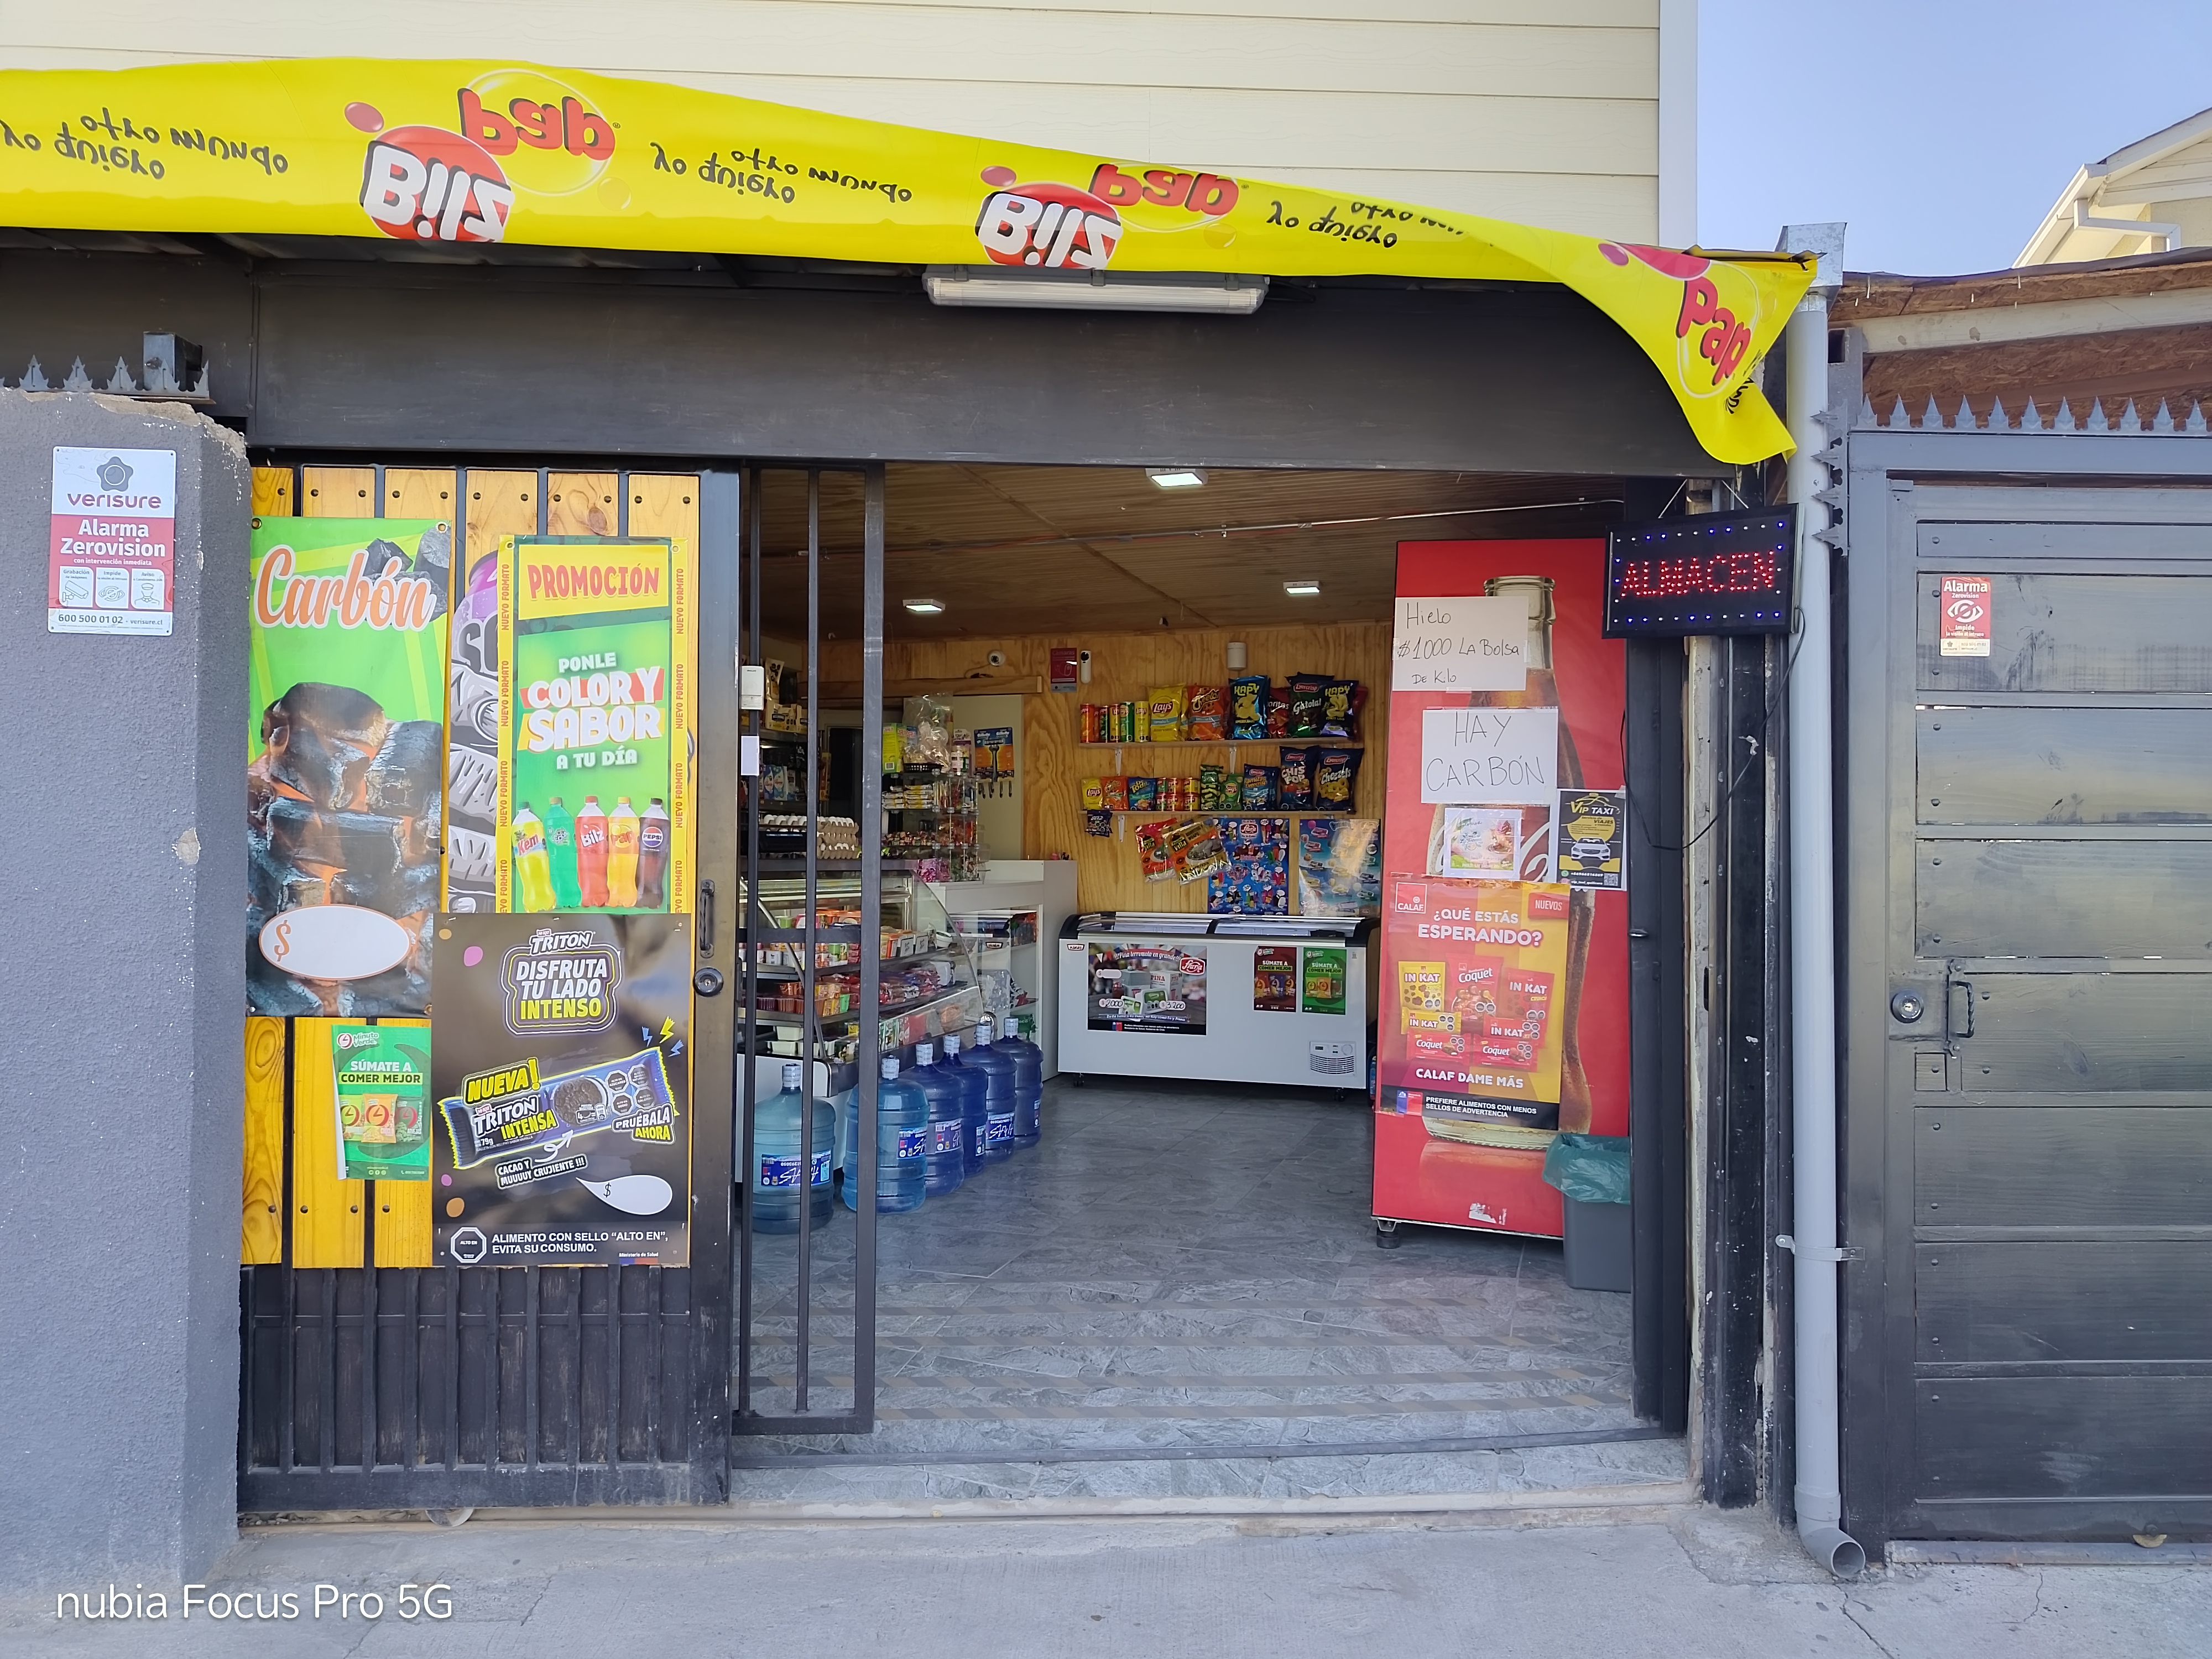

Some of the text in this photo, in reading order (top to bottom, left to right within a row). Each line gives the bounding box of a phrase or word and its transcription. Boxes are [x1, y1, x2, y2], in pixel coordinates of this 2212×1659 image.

[67, 493, 161, 509] verisure
[79, 519, 149, 538] Alarma
[60, 537, 165, 557] Zerovision
[528, 564, 659, 600] PROMOCIÓN
[1621, 551, 1773, 597] ALMACEN
[256, 546, 435, 630] Carbón
[1943, 580, 1987, 592] Alarma
[501, 564, 510, 630] NUEVO FORMATO
[1406, 602, 1452, 629] Hielo
[1397, 636, 1452, 660] $1000
[1480, 639, 1520, 656] Bolsa
[559, 652, 617, 672] PONLE
[1434, 668, 1457, 684] Kilo
[528, 666, 661, 708] COLOR Y
[528, 705, 662, 753] SABOR
[1454, 711, 1511, 747] HAY
[557, 745, 637, 769] A TU DÍA
[500, 760, 508, 797] FORMATO
[1426, 756, 1545, 792] CARBÓN
[518, 833, 539, 856] Kem
[581, 830, 604, 847] Bilz
[1433, 907, 1519, 924] ¿QUÉ ESTÁS
[1535, 900, 1563, 911] NUEVOS
[274, 920, 291, 962] $
[533, 933, 590, 953] TRITON
[1418, 924, 1542, 946] ESPERANDO?
[517, 958, 607, 980] DISFRUTA
[1404, 973, 1440, 983] IN KAT
[1459, 968, 1493, 983] Coquet
[521, 979, 601, 1000] TU LADO
[520, 998, 601, 1020] INTENSO
[353, 1032, 378, 1042] Minuto
[1491, 1027, 1524, 1037] IN KAT
[1416, 1039, 1443, 1050] Coquet
[351, 1059, 412, 1072] SÚMATE A
[341, 1074, 420, 1083] COMER MEJOR
[1416, 1068, 1524, 1088] CALAF DAME MÁS
[1426, 1097, 1457, 1105] PREFIERE
[1458, 1100, 1496, 1110] ALIMENTOS
[1513, 1106, 1537, 1114] MENOS
[1462, 1108, 1508, 1118] ADVERTENCIA
[474, 1098, 536, 1135] TRITON
[500, 1109, 557, 1140] INTENSA
[615, 1107, 670, 1129] PRUÉBALA
[481, 1138, 494, 1146] 79g
[635, 1125, 671, 1140] AHORA
[498, 1160, 529, 1175] CACAO Y
[534, 1160, 575, 1177] CRUJIENTE
[603, 1182, 612, 1198] $
[492, 1233, 546, 1244] ALIMENTO
[549, 1233, 572, 1242] CON
[574, 1232, 609, 1242] SELLO
[492, 1243, 597, 1254] EVITA SU CONSUMO.
